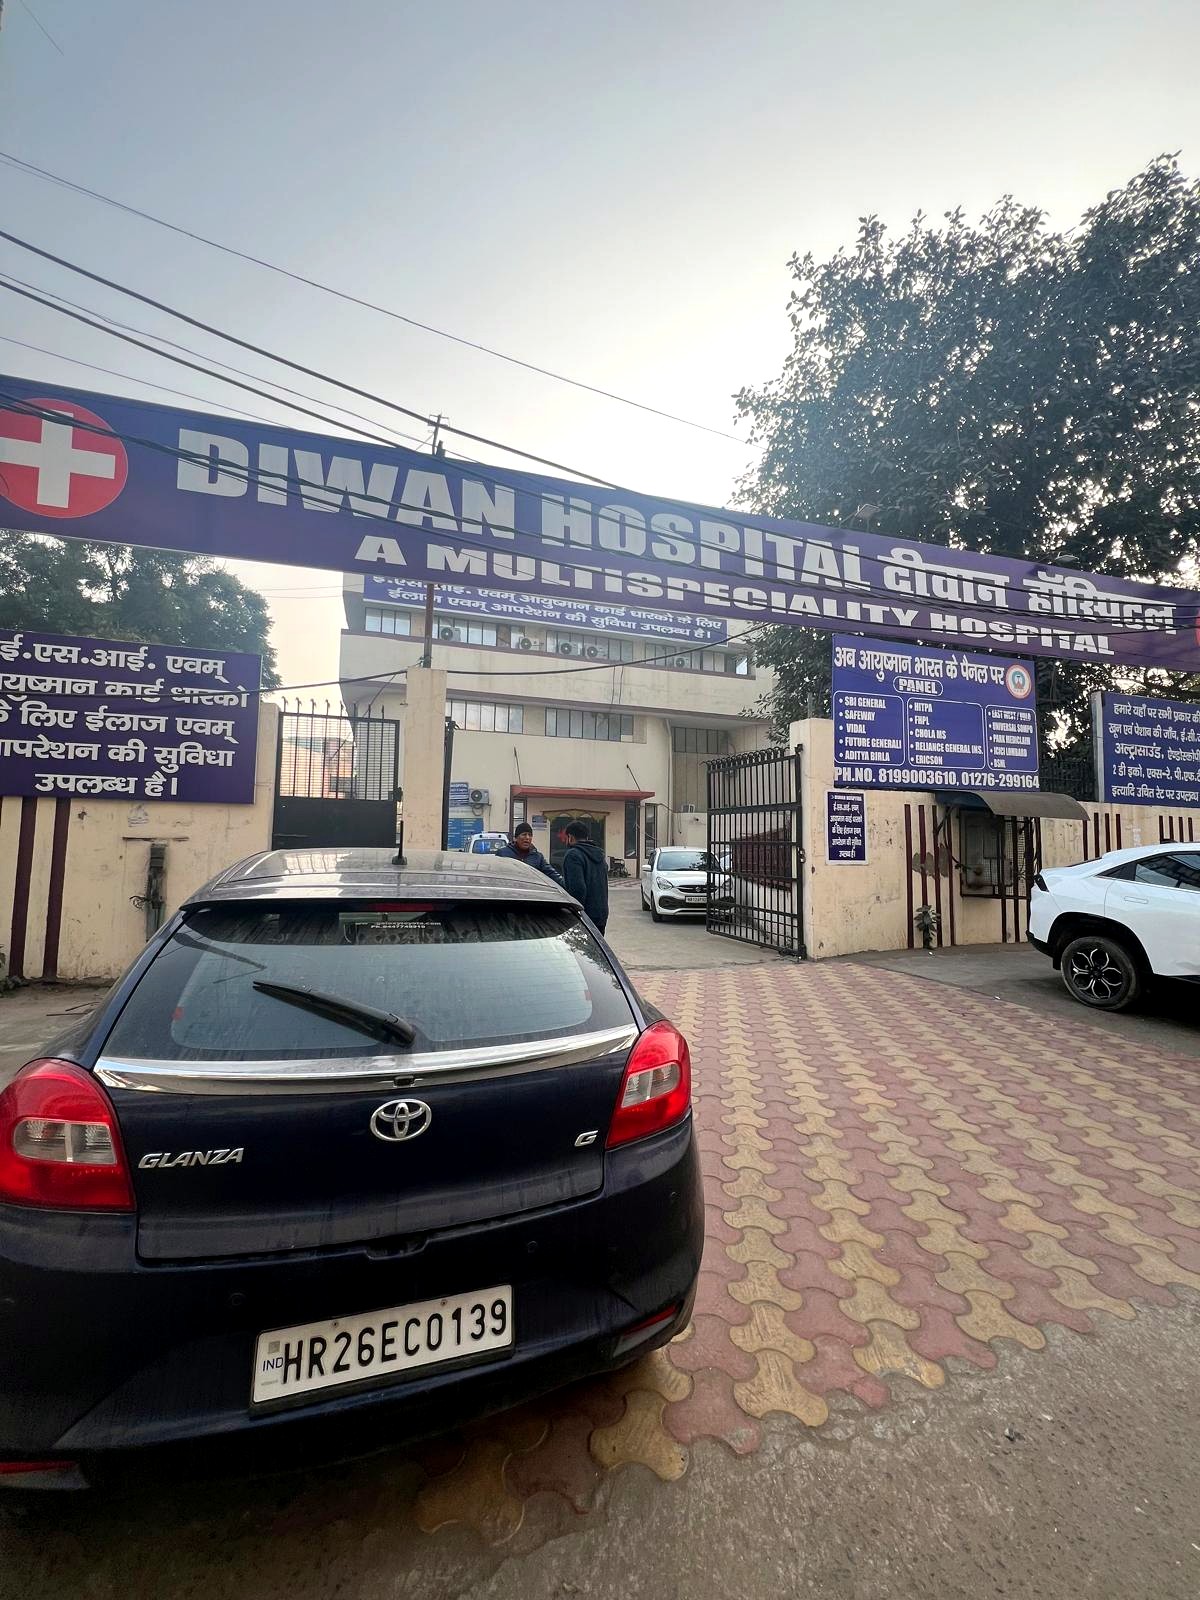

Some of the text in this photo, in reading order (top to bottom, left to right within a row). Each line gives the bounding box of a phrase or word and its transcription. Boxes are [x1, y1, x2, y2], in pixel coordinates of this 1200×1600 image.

[177, 428, 870, 591] DIWAN HOSPITAL
[354, 535, 1115, 655] A MULTISPECIALITY HOSPITAL
[877, 547, 1176, 634] दीवान हॉस्पिटल
[491, 602, 560, 619] आपरेशन
[564, 611, 587, 623] की
[591, 616, 636, 630] सुविधा
[519, 594, 591, 612] आयुष्मान
[696, 617, 722, 629] लिए
[165, 655, 230, 684] एवम्
[834, 646, 1005, 685] अब आयुष्मान भारत के पैनल पर
[0, 673, 98, 702] युष्मान
[104, 679, 164, 702] कार्ड
[899, 678, 938, 694] PANEL
[844, 696, 886, 709] SBI GENERAL
[914, 702, 932, 713] HITPA
[1113, 702, 1131, 716] हमारे
[1147, 708, 1156, 718] पर
[20, 700, 78, 728] लिए
[84, 705, 168, 733] ईलाज
[175, 717, 239, 744] एवम्
[844, 709, 876, 721] SAFEWAY
[846, 723, 866, 734] VIDAL
[914, 728, 936, 739] CHOLA
[1108, 722, 1121, 738] खून
[1123, 722, 1132, 736] एवं
[1153, 725, 1162, 738] की
[844, 736, 902, 749] FUTURE GENERALI
[915, 741, 944, 752] RELIANCE
[945, 743, 971, 754] GENERAL
[107, 738, 147, 763] की
[154, 742, 235, 774] सुविधा
[844, 750, 890, 762] ADITYA BIRLA
[915, 754, 943, 765] ERICSON
[835, 766, 1040, 788] PH.NO. 8199003610, 01276-299164
[1118, 762, 1126, 776] डी
[35, 773, 138, 794] उपलब्ध
[1111, 782, 1135, 797] इत्यादि
[1137, 784, 1154, 798] उचित
[1156, 785, 1165, 799] रेट
[1165, 788, 1175, 800] पर
[138, 1130, 599, 1168] GLANZA G
[283, 1298, 507, 1385] HR26EC0139
[262, 1356, 284, 1372] IND
